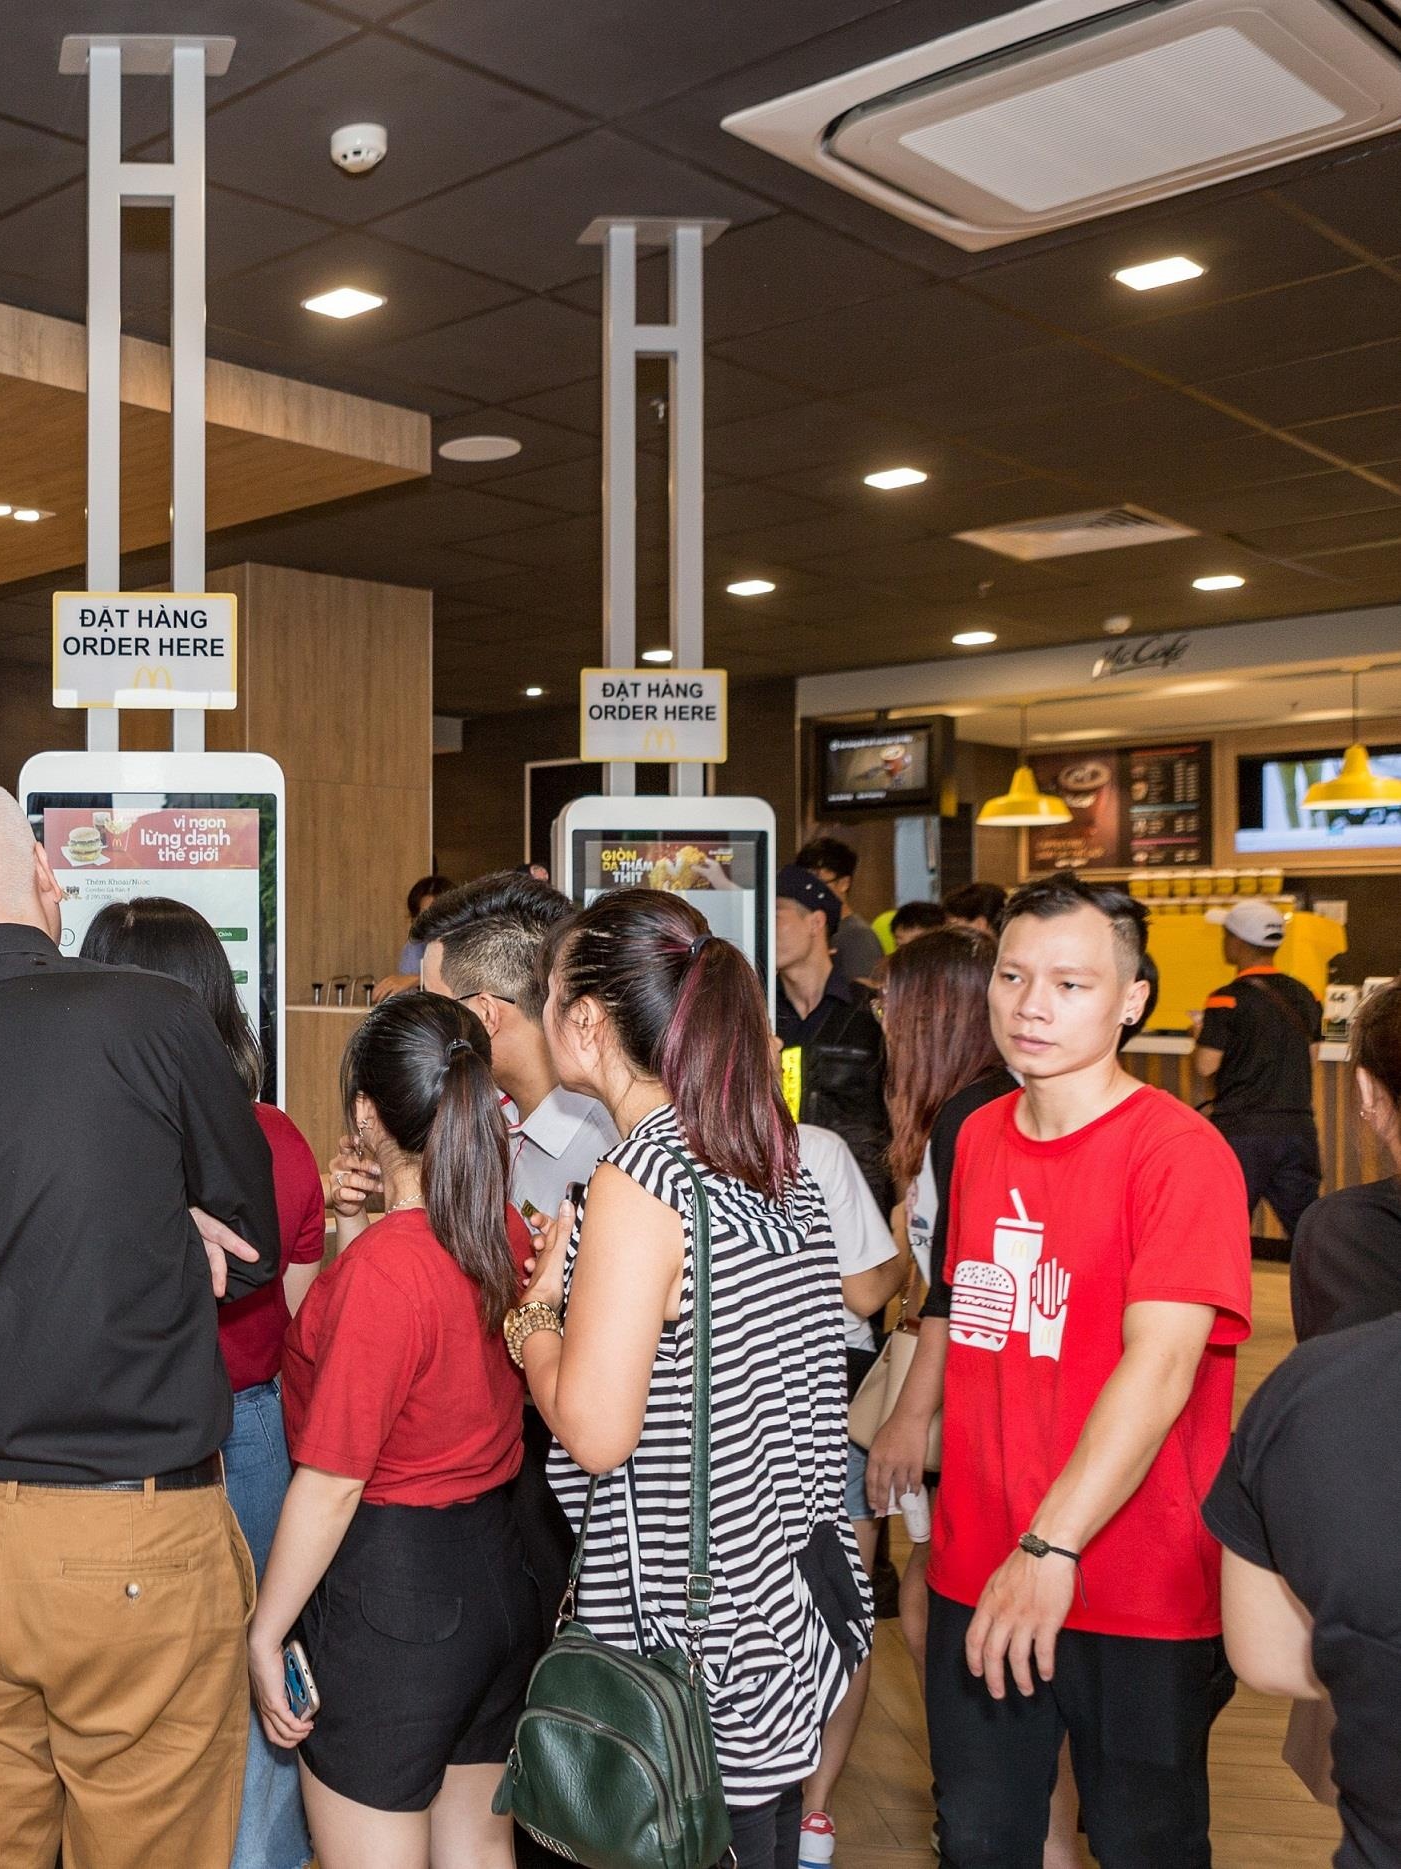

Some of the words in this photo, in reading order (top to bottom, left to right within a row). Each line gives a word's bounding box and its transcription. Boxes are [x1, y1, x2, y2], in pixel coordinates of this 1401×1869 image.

[79, 606, 130, 632] ĐẶT
[138, 604, 208, 629] HÀNG
[62, 636, 150, 656] ORDER
[159, 637, 225, 657] HERE
[601, 680, 641, 702] ĐẶT
[648, 679, 703, 698] HÀNG
[589, 704, 658, 720] ORDER
[664, 705, 717, 721] HERE
[173, 815, 186, 831] vị
[189, 817, 226, 832] ngon
[140, 829, 181, 849] lừng
[184, 829, 231, 846] danh
[158, 847, 187, 863] thế
[190, 846, 219, 865] giới
[601, 847, 637, 862] GIÒN
[602, 861, 620, 872] DA
[612, 871, 644, 887] THỊT
